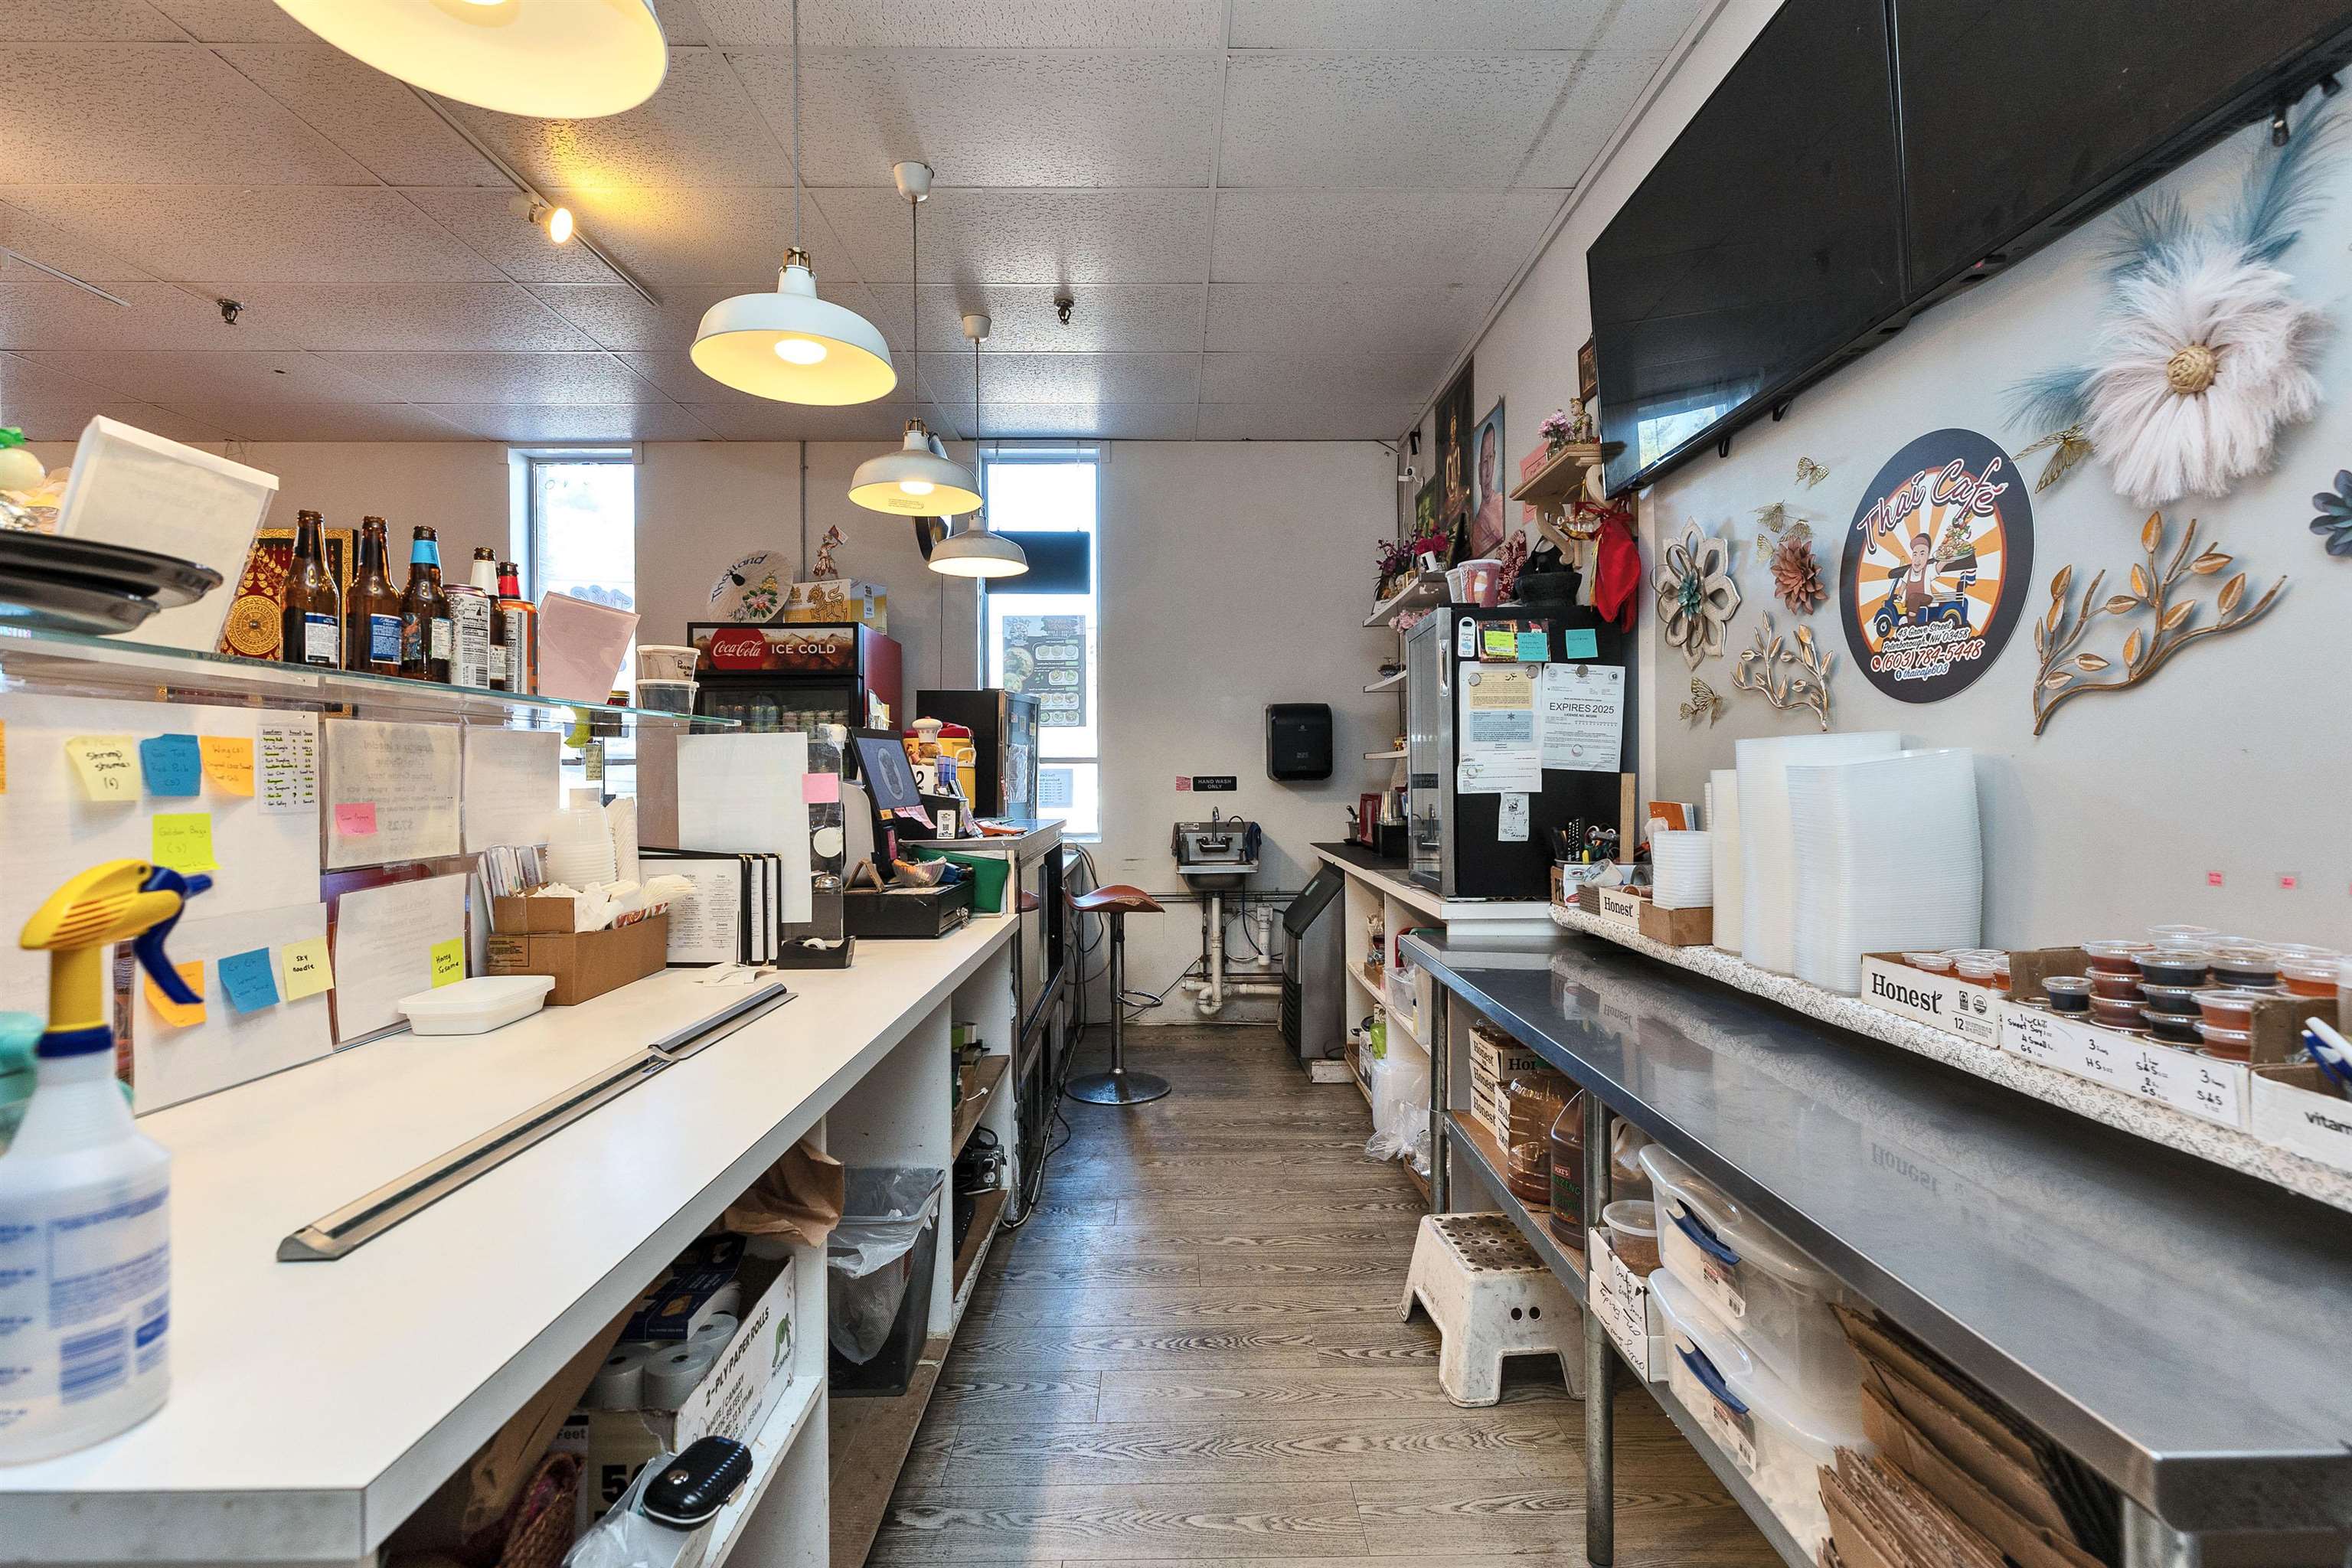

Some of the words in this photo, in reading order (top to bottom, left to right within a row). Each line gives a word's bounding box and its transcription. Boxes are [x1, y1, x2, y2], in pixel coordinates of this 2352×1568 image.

[1857, 471, 1926, 552] Thai
[711, 554, 767, 603] Thailand
[1898, 628, 1906, 637] 43
[1909, 626, 1928, 636] Grove
[1930, 634, 1941, 643] NH
[1942, 629, 1969, 641] 03458
[714, 640, 763, 658] Coca-Cola
[772, 645, 792, 654] ICE
[799, 645, 836, 654] COLD
[1883, 652, 1916, 671] (603)
[1916, 640, 1984, 666] 784-5448
[1903, 664, 1949, 680] thaicafe603
[1550, 702, 1591, 712] EXPIRES
[1592, 704, 1615, 714] 2025
[1604, 897, 1633, 918] Honest
[292, 963, 315, 972] noodle
[438, 961, 459, 974] Sesame
[1872, 972, 1943, 1015] Honest
[1954, 1017, 1965, 1031] 12
[2089, 1039, 2096, 1050] 3
[1473, 1040, 1494, 1067] Honest
[1474, 1067, 1495, 1094] Honest
[2145, 1077, 2151, 1086] 2
[2200, 1070, 2210, 1083] 3
[1473, 1096, 1496, 1126] Honest
[706, 1363, 729, 1407] 2-PLY
[729, 1332, 750, 1374] PAPER
[750, 1306, 769, 1342] ROLLS
[725, 1371, 744, 1407] CANARY
[557, 1428, 586, 1439] Feet
